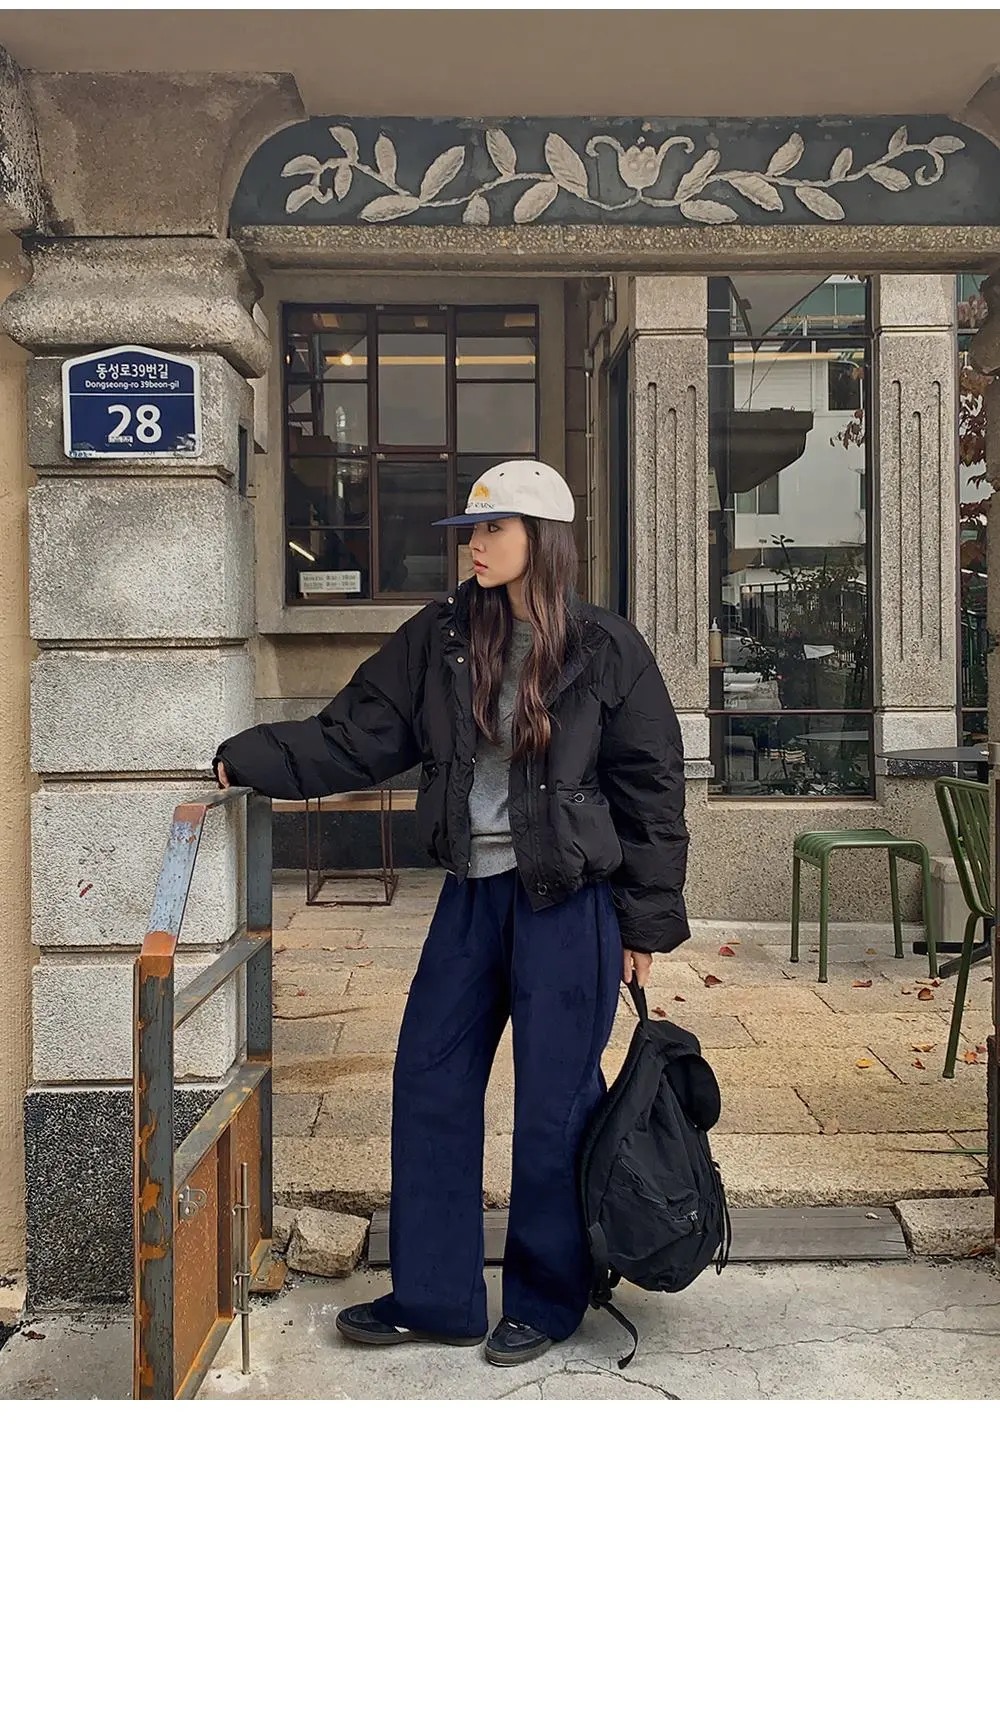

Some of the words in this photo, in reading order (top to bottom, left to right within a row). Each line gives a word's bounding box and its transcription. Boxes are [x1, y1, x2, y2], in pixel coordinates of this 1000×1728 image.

[96, 363, 169, 380] 동성로39번길
[85, 380, 140, 390] Dongseong-ro
[140, 380, 180, 390] 39beon-gil
[108, 404, 162, 444] 28
